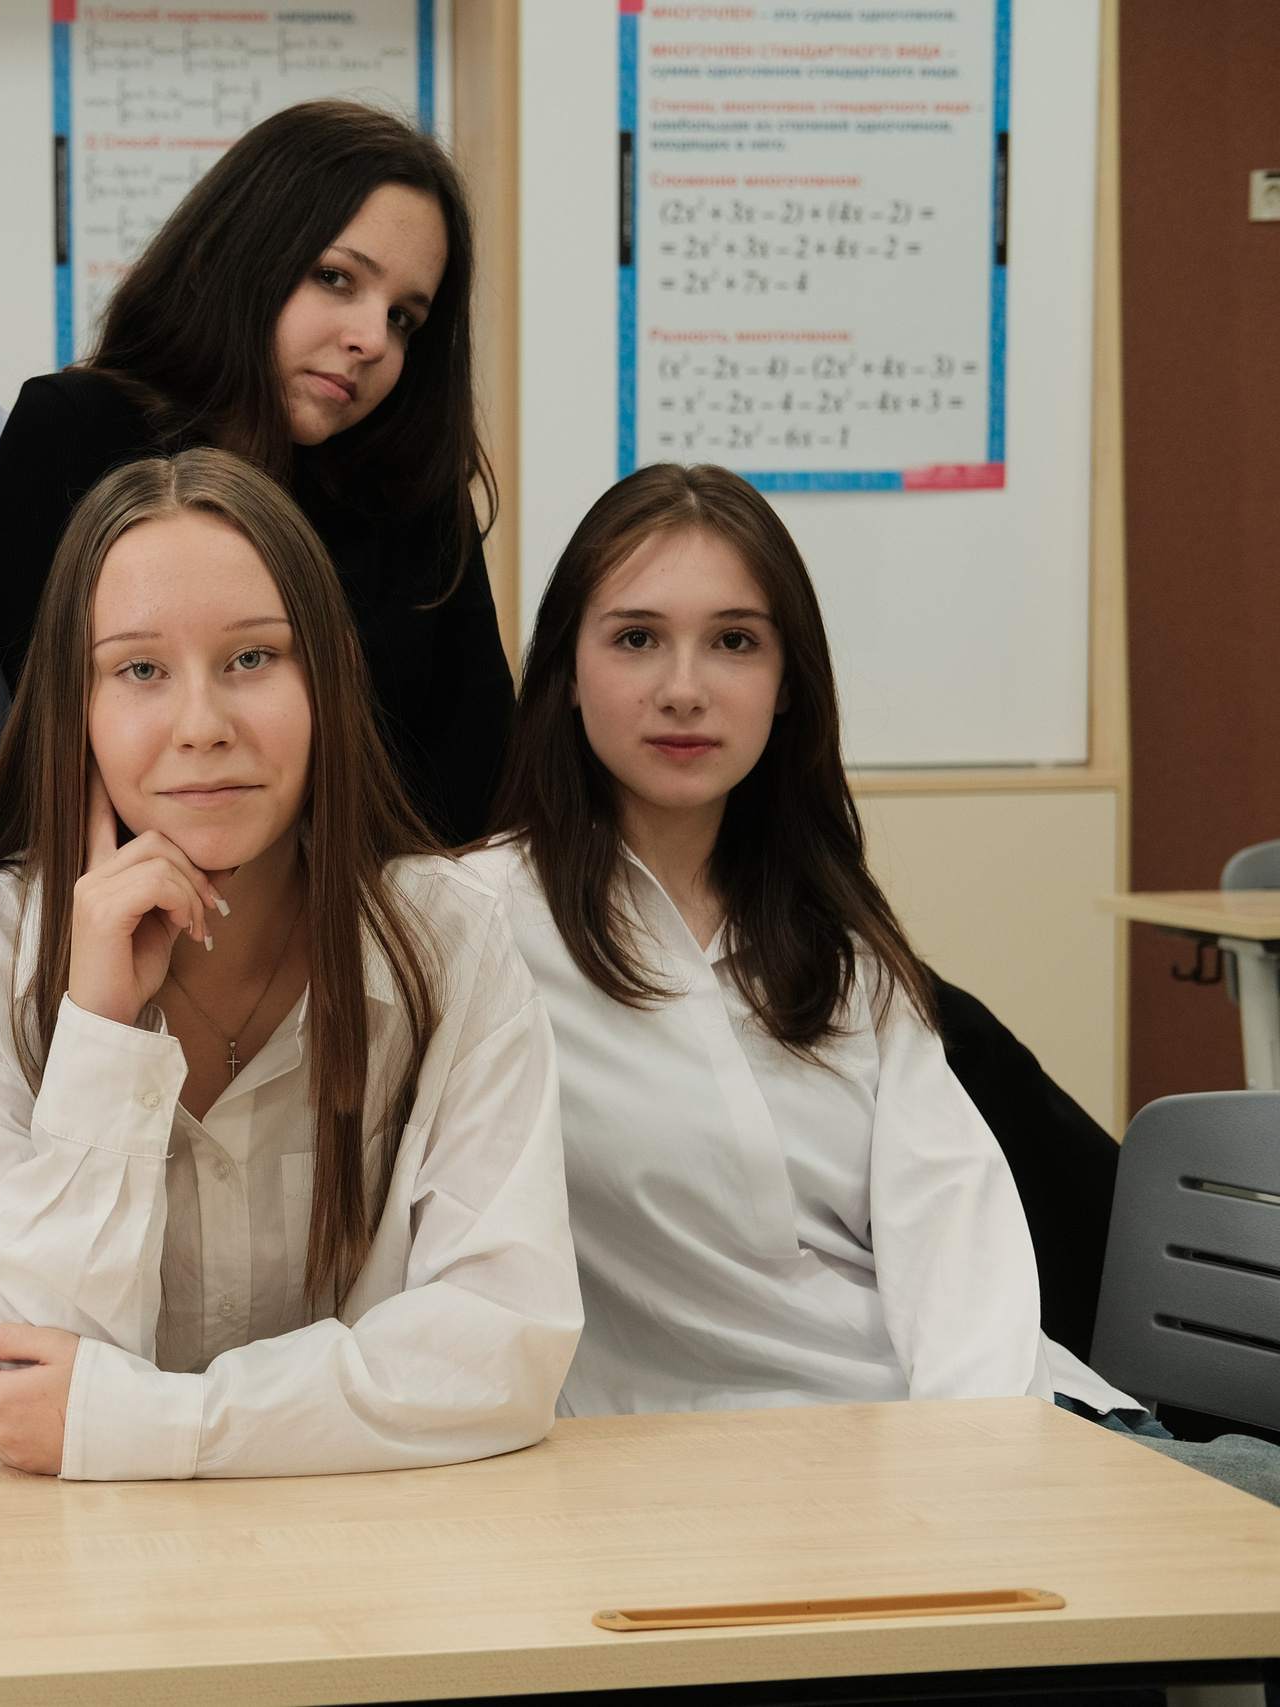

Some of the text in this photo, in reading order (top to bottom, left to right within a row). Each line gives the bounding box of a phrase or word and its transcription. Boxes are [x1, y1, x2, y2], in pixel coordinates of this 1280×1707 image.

[650, 6, 755, 20] МНОГОЧЛЕН
[772, 10, 796, 21] это
[803, 10, 852, 23] сумма
[650, 44, 942, 60] МНОГОЧЛЕН СТАНДАРТНОГО ВИДА
[650, 66, 701, 79] сумма
[705, 66, 803, 78] одночленов
[807, 66, 914, 79] стандартного
[651, 99, 717, 113] Степень
[821, 101, 928, 115] стандартного
[933, 102, 972, 114] вида
[650, 172, 739, 187] Сложение
[649, 328, 730, 343] Разность
